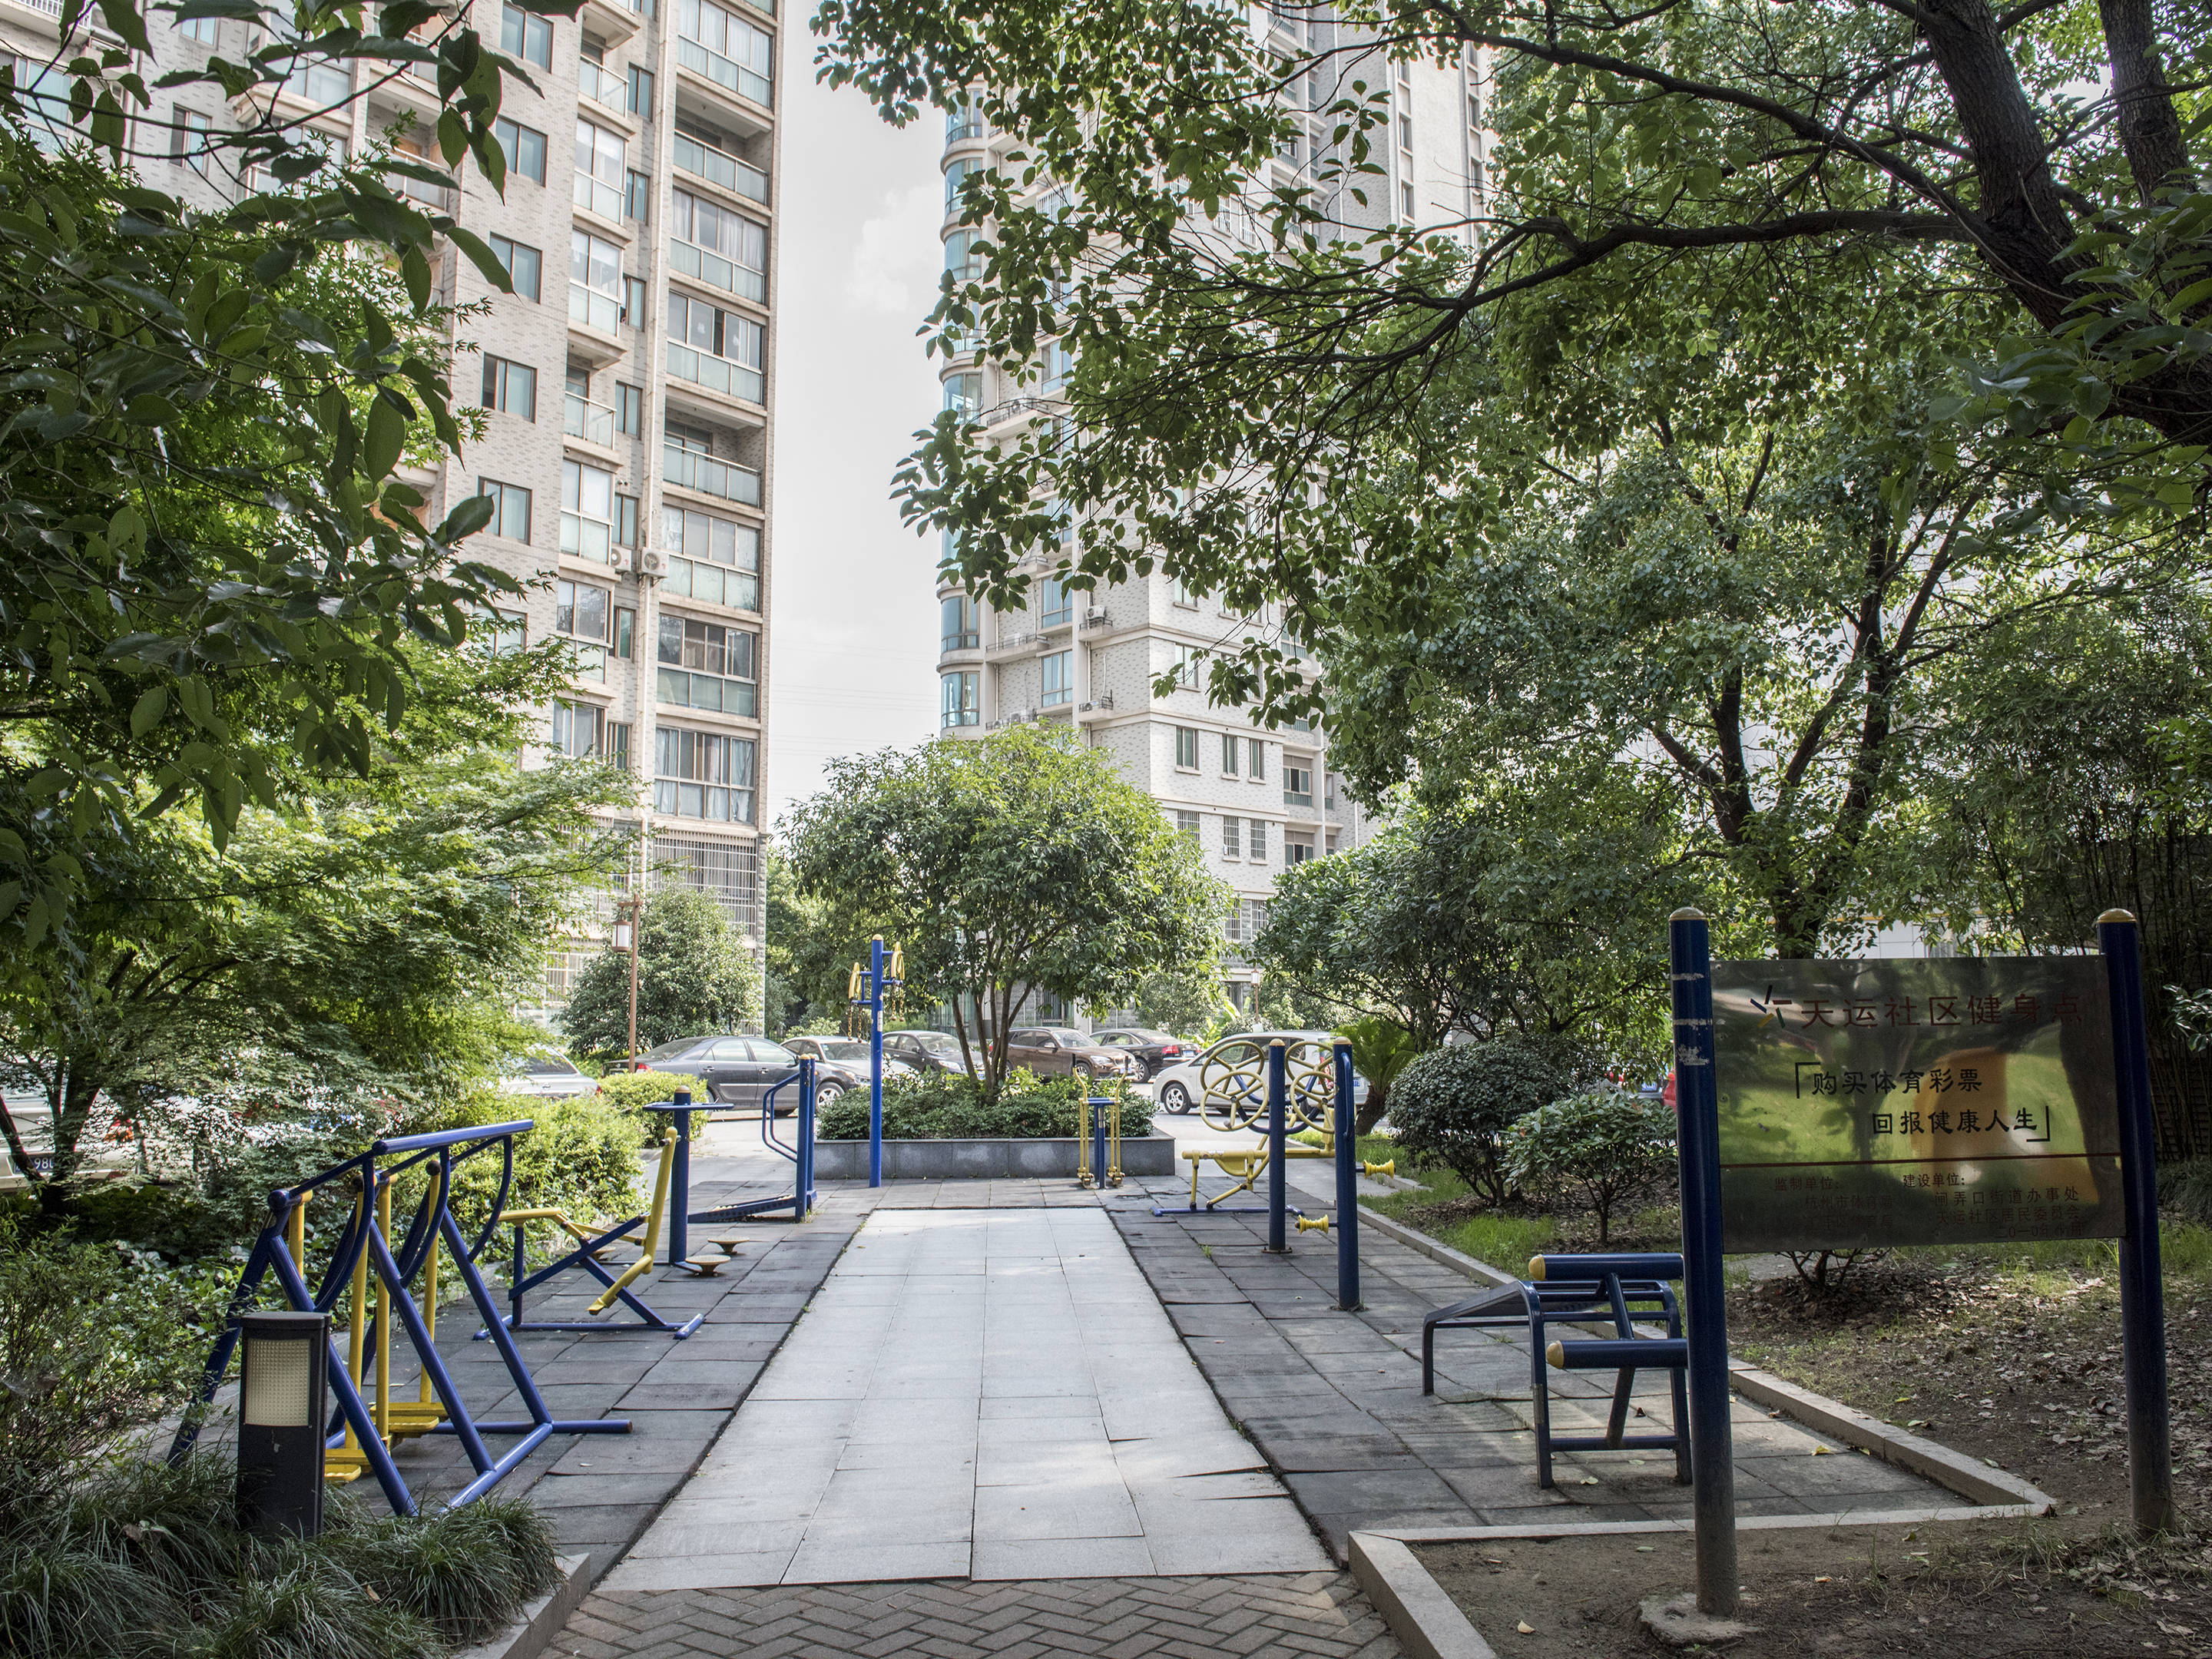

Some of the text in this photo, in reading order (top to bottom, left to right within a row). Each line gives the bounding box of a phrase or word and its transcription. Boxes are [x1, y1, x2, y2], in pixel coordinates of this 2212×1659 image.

[1800, 993, 2082, 1030] 天运社区健身点
[1902, 1173, 1965, 1188] 建设单位：
[1804, 1194, 1893, 1210] 杭州市体育局
[1935, 1186, 2079, 1207] 闸弄口街道办事处
[1936, 1204, 2081, 1226] 天运社区居民委员会
